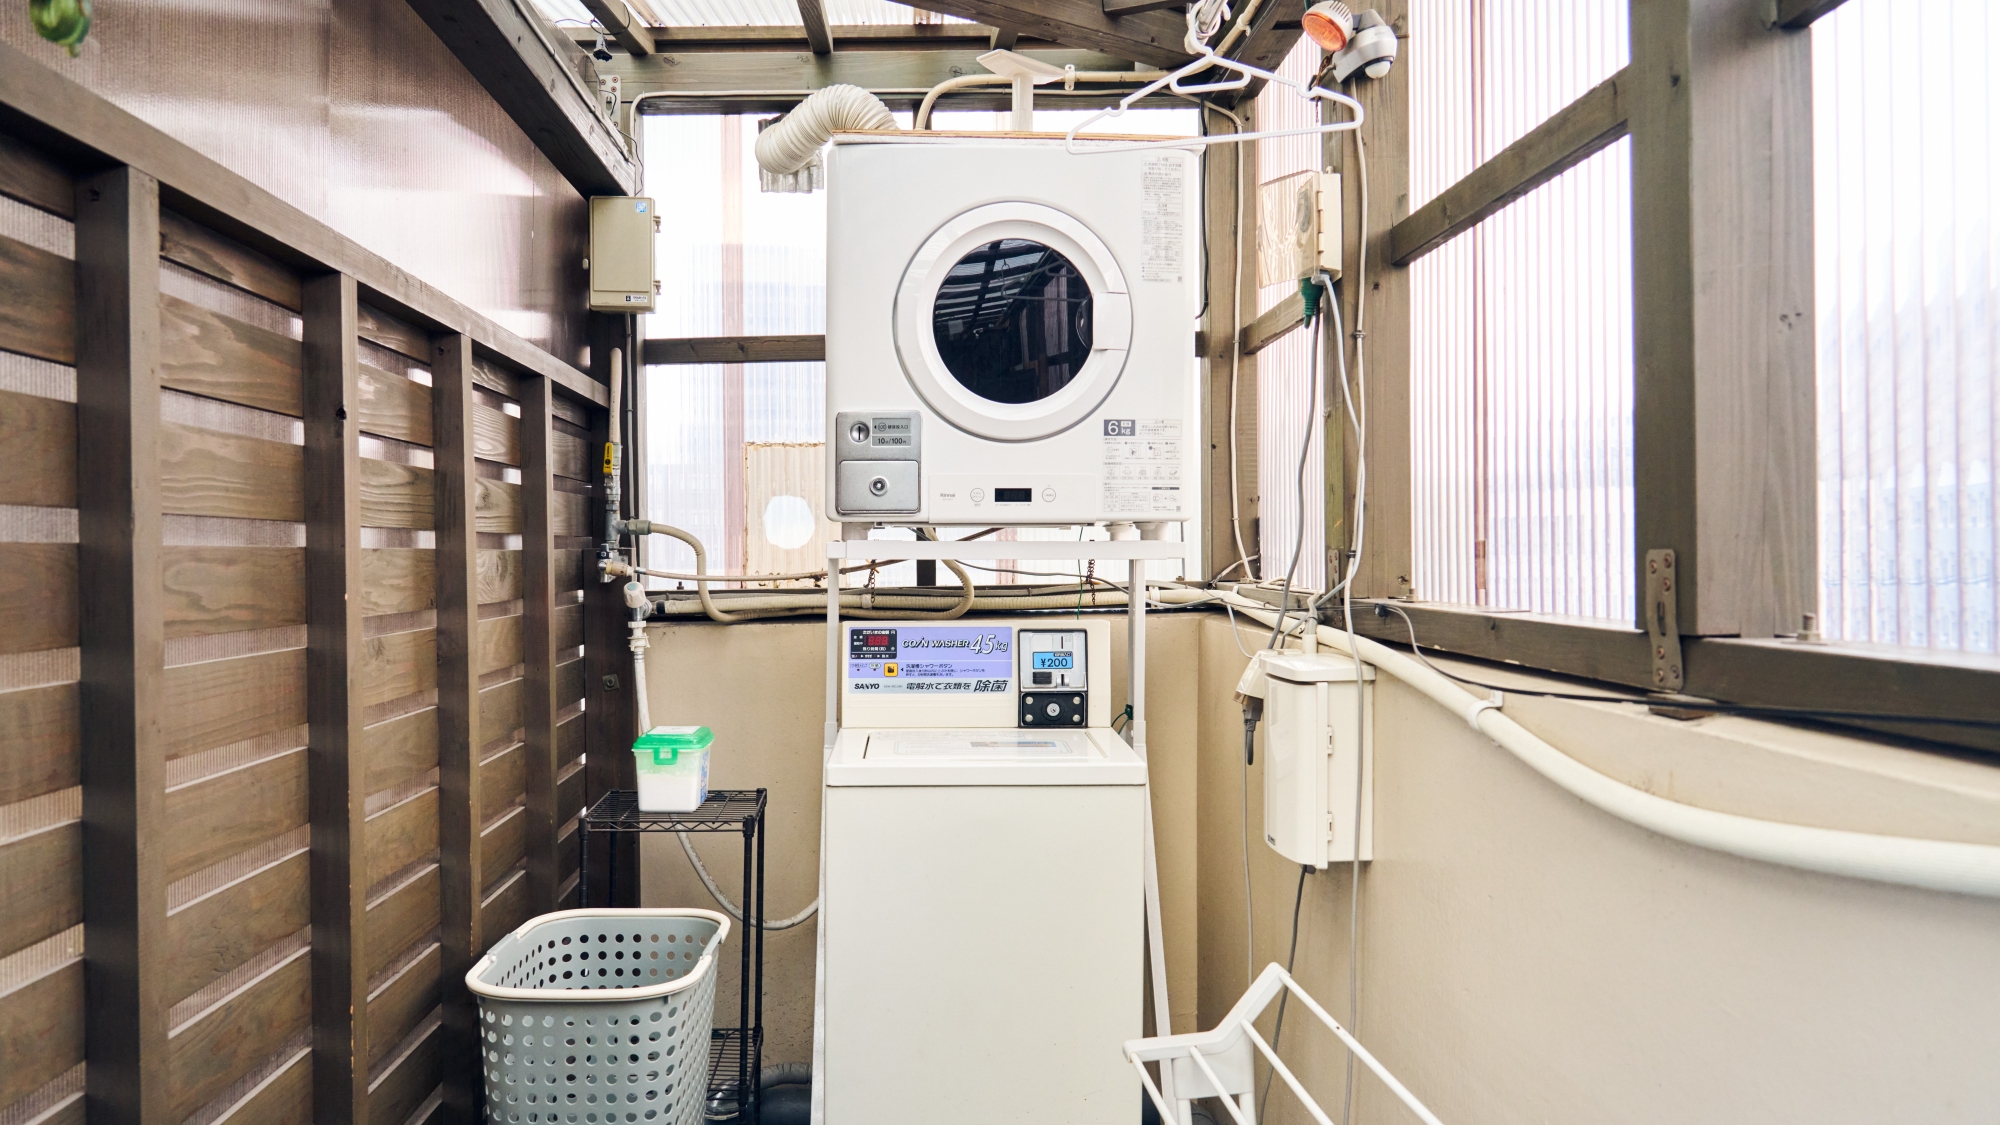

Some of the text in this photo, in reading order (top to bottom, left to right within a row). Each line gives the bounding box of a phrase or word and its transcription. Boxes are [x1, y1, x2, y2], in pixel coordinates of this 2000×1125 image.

[1108, 420, 1119, 435] 6
[1121, 427, 1131, 435] kg
[901, 636, 929, 648] COIN
[931, 639, 970, 648] WASHER
[1040, 658, 1068, 668] ¥200
[906, 679, 1009, 693] 電解水で衣類を 除菌
